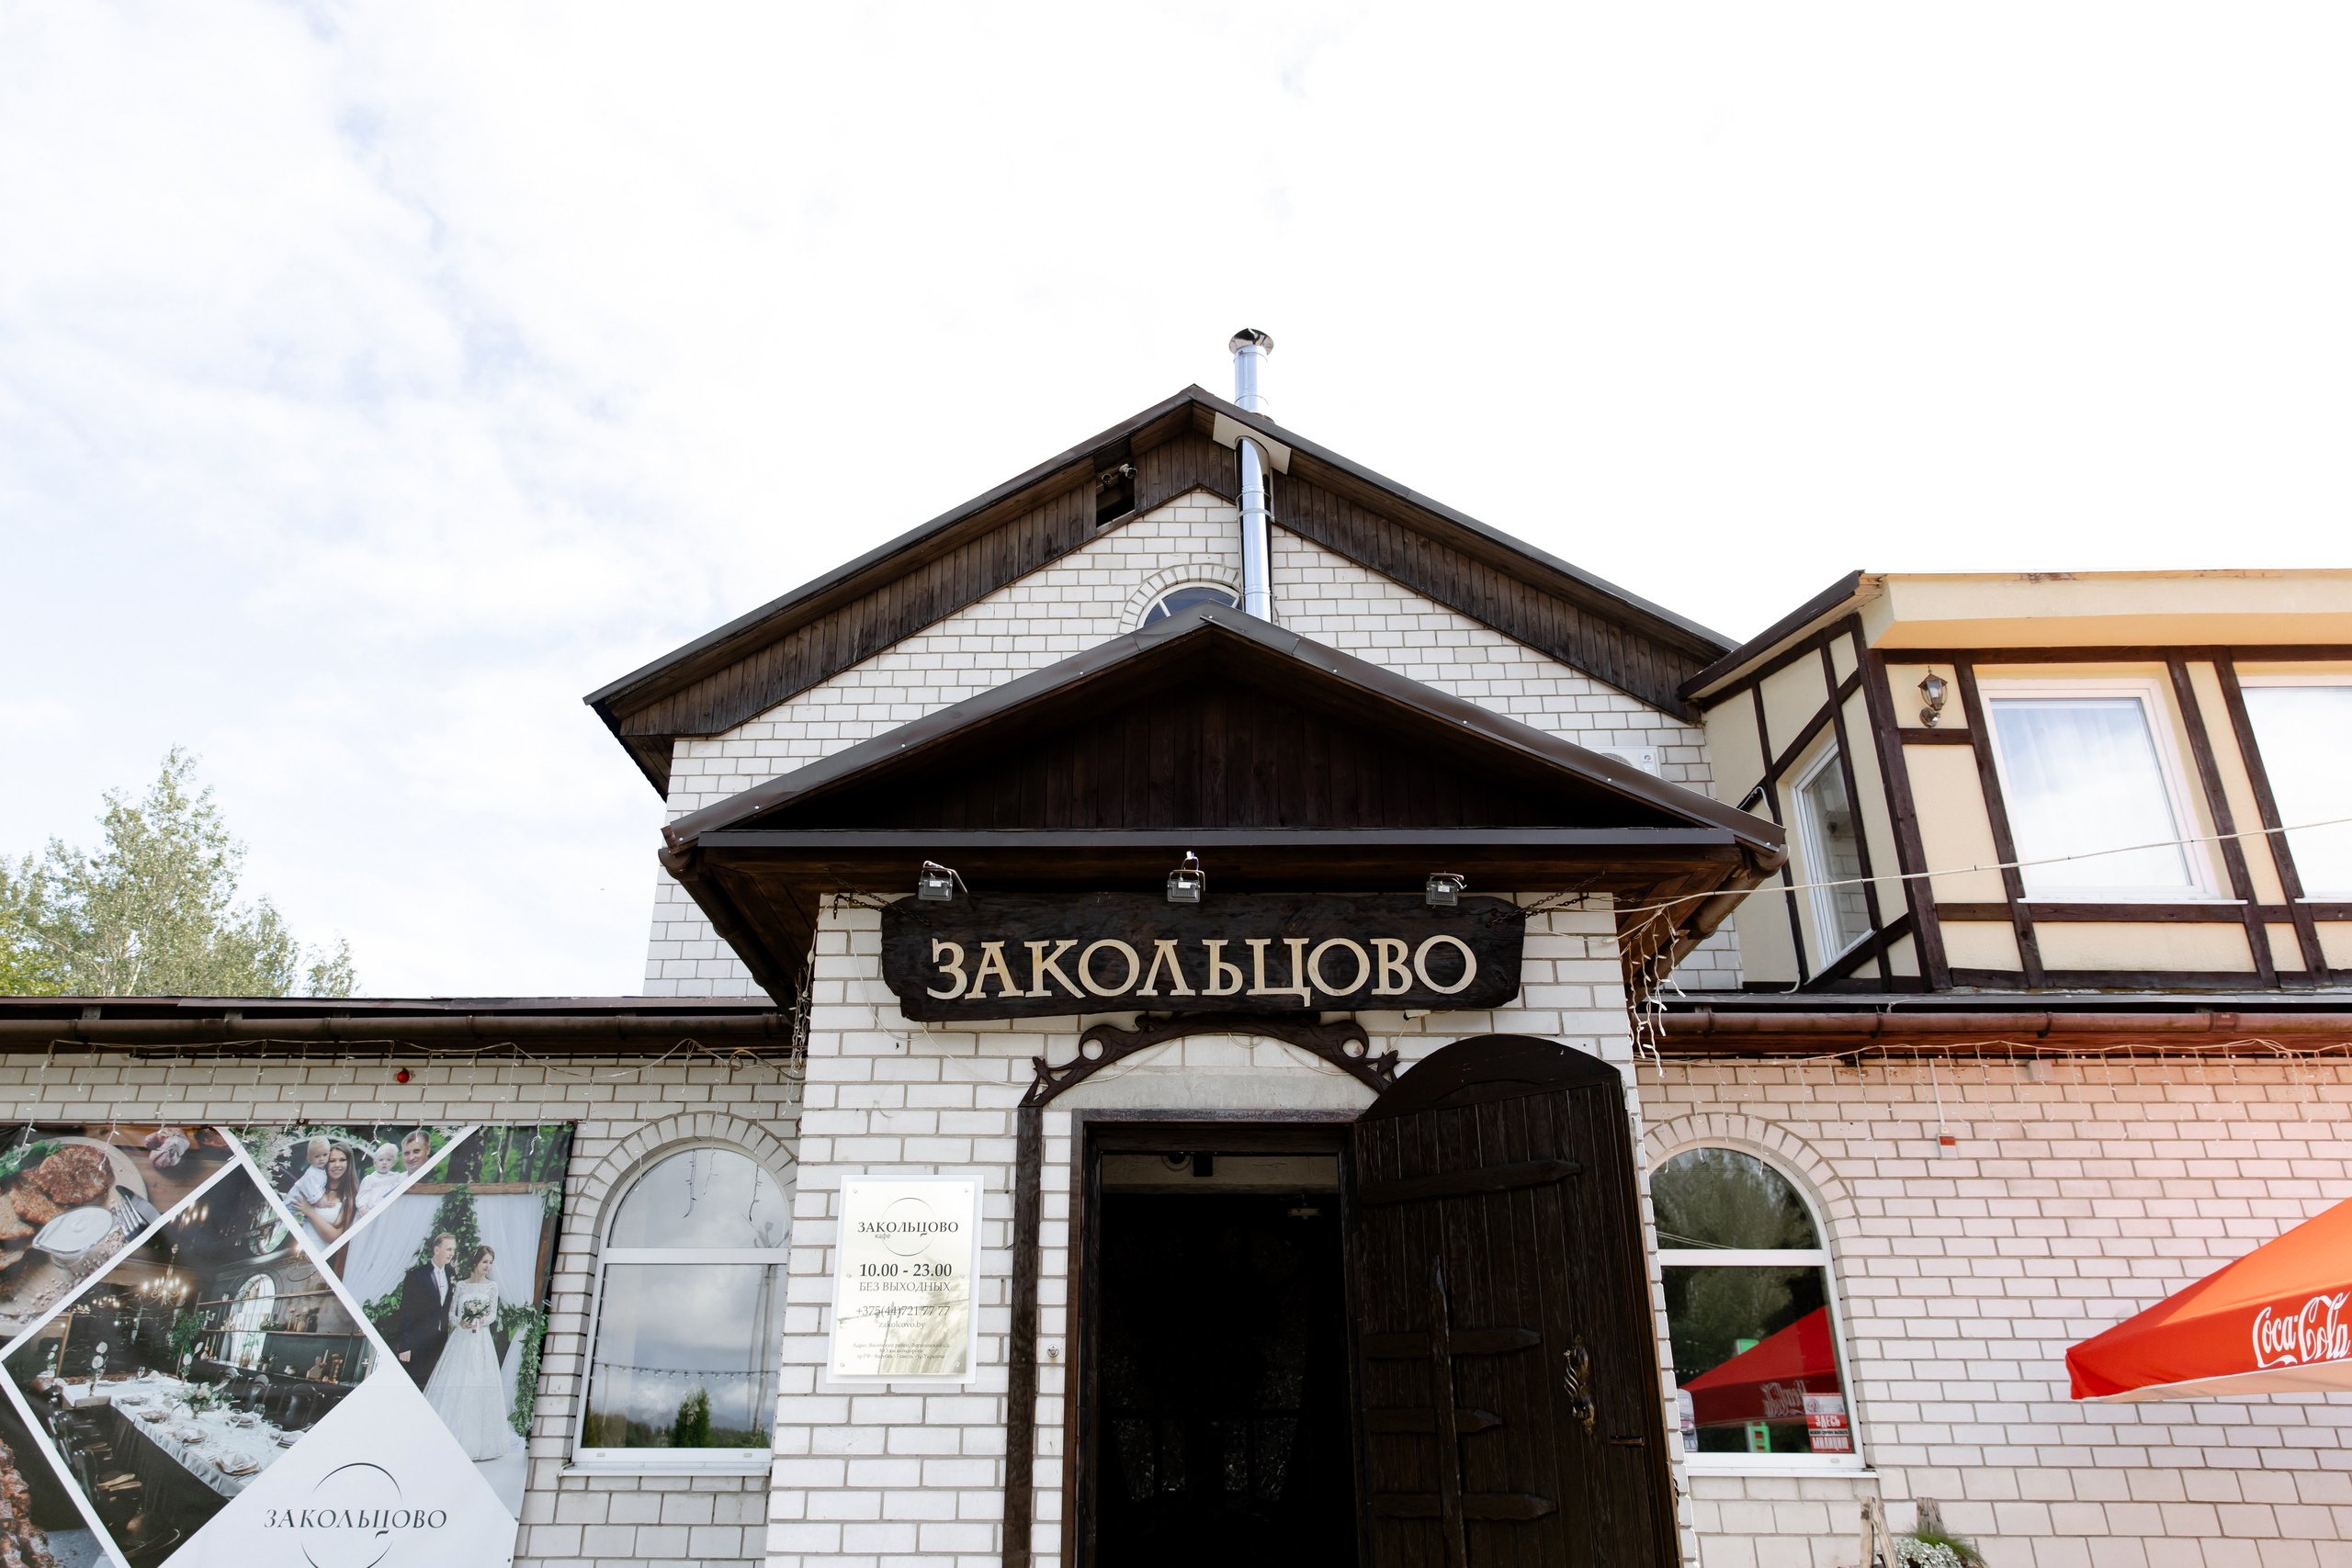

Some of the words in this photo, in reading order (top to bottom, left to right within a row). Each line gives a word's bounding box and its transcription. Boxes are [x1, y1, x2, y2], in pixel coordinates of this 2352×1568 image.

[926, 934, 1477, 1008] ЗАКОЛЬЦОВО
[857, 1221, 958, 1237] ЗАКОЛЬЦОВО
[859, 1263, 899, 1277] 10.00
[912, 1263, 952, 1277] 23.00
[859, 1281, 879, 1292] БЕЗ
[882, 1281, 951, 1293] ВЫХОДНЫХ
[922, 1305, 935, 1316] 77
[937, 1305, 951, 1316] 77
[878, 1320, 926, 1330] zakolcovo.by
[2252, 1291, 2352, 1369] Coca-Cola
[1815, 1415, 1841, 1428] ЗДЕСЬ
[1812, 1437, 1849, 1451] МИЛИЦИЮ
[264, 1507, 447, 1540] ЗАКОЛЬЦОВО
